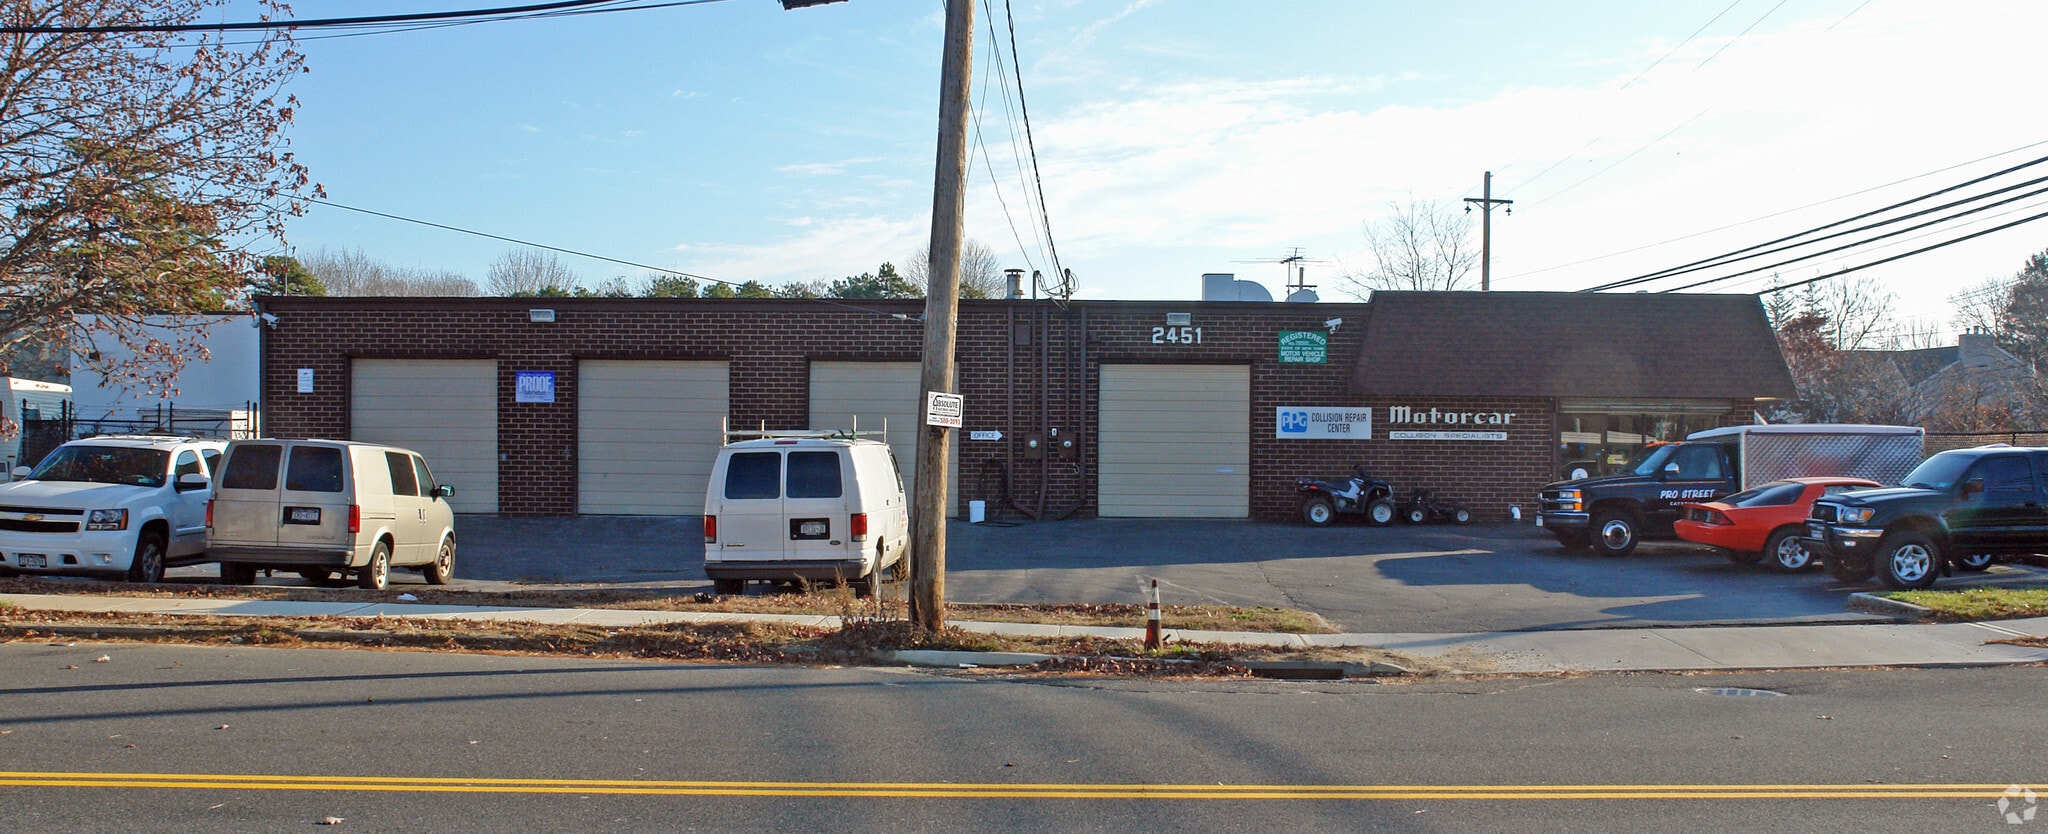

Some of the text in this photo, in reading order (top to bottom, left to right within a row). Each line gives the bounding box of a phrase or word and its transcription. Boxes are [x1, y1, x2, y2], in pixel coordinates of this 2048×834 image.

[1152, 326, 1202, 344] 2451
[1280, 331, 1327, 346] REGISTERED
[1301, 350, 1325, 358] VEHICLE
[519, 376, 552, 393] PROOF
[1282, 411, 1307, 430] PPG
[1311, 412, 1367, 423] COLLISION REPAIR
[1389, 405, 1517, 425] Motorcar
[1327, 423, 1351, 434] CENTER
[1444, 432, 1503, 440] SPECIALISTS
[1660, 488, 1716, 500] PRO STREET
